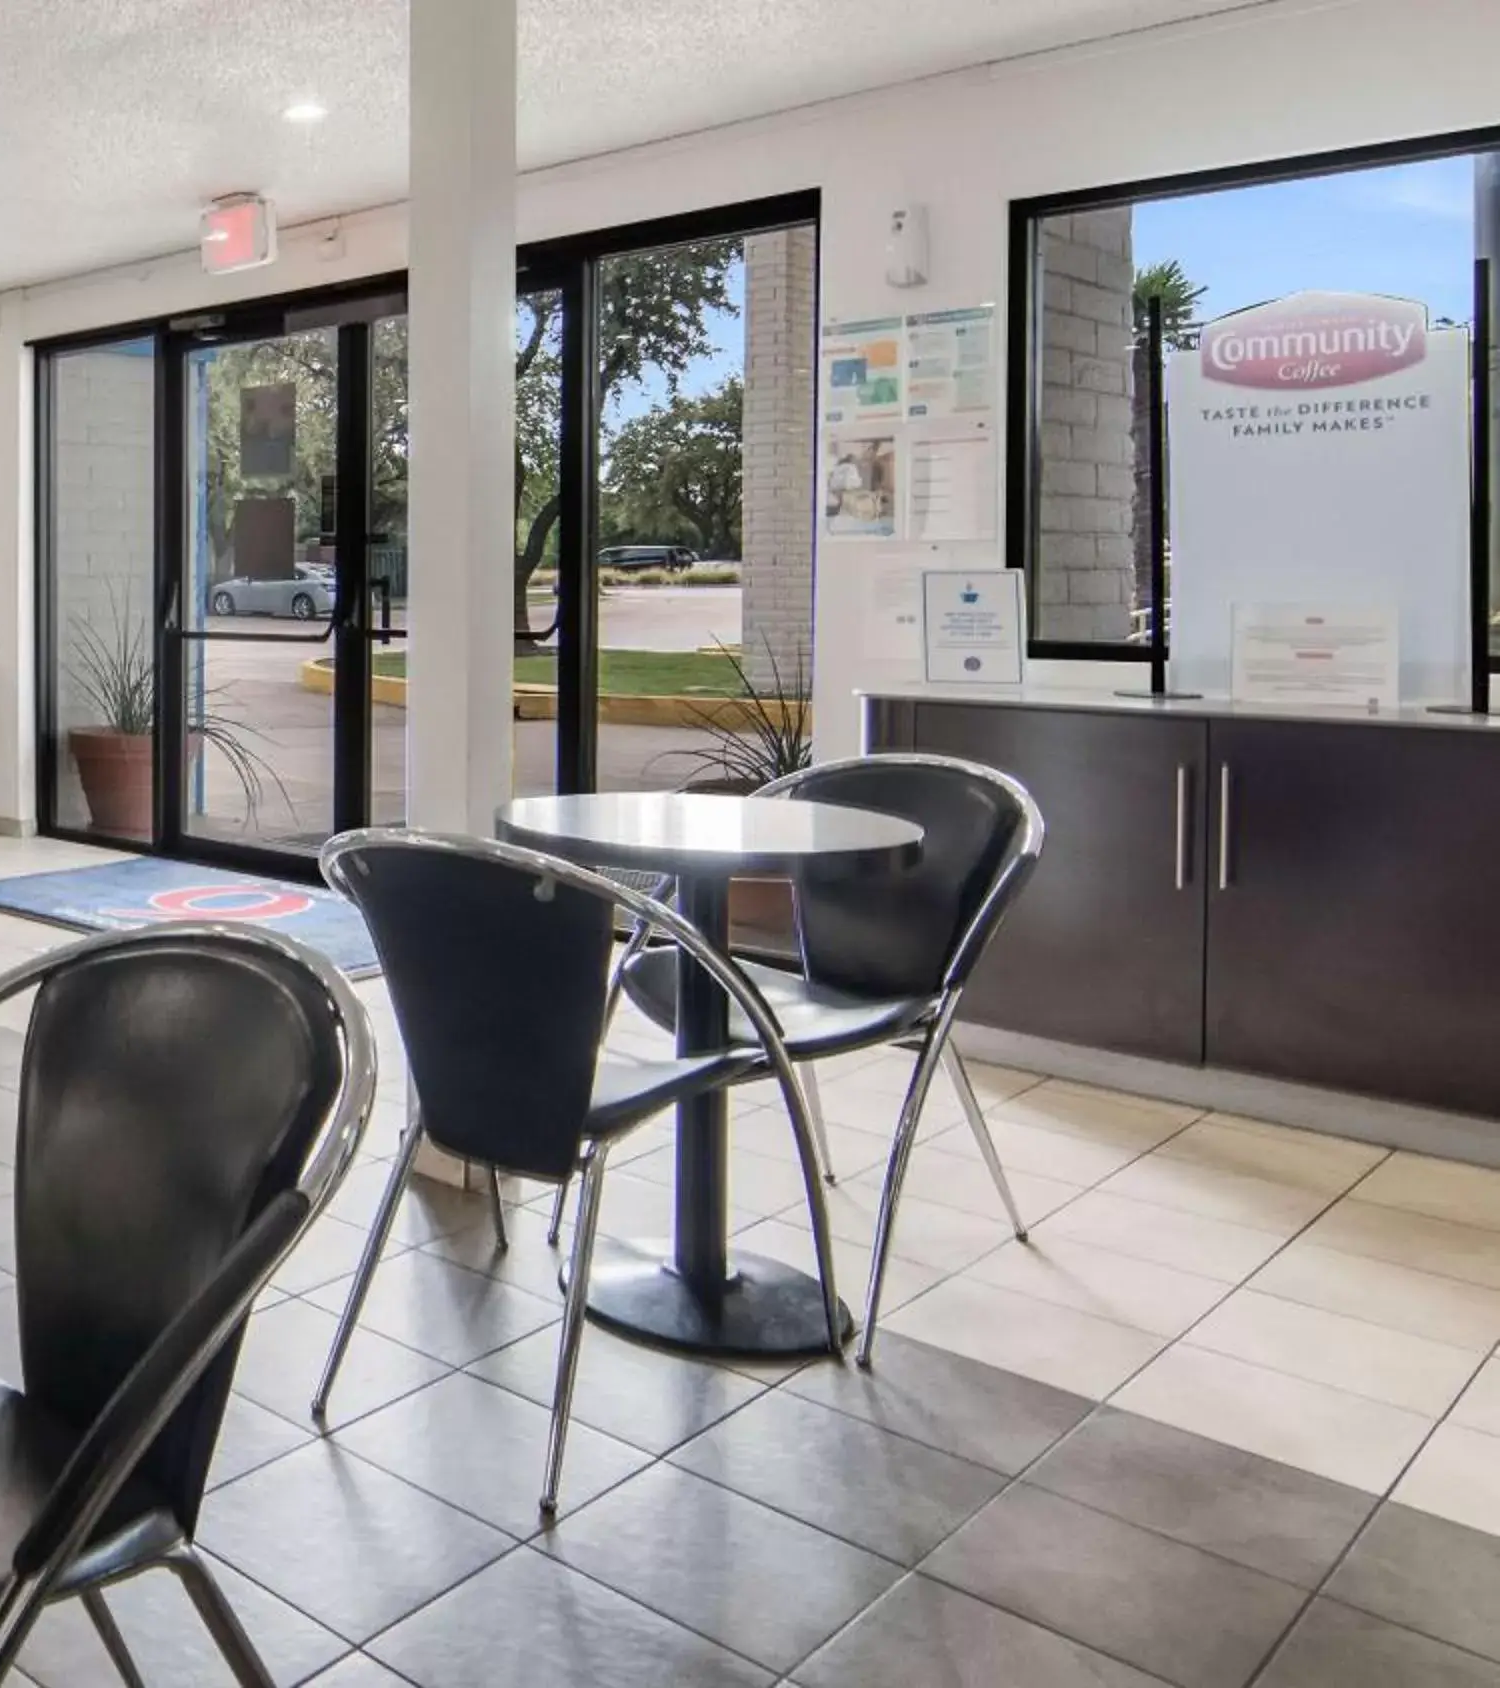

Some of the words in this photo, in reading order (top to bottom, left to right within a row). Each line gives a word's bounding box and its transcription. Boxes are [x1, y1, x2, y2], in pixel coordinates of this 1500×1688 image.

[1211, 318, 1415, 371] Community
[1277, 359, 1342, 383] Coffee
[1202, 407, 1260, 421] TASTE
[1267, 406, 1293, 418] the
[1297, 395, 1430, 416] DIFFERENCE
[1233, 420, 1303, 437] FAMILY
